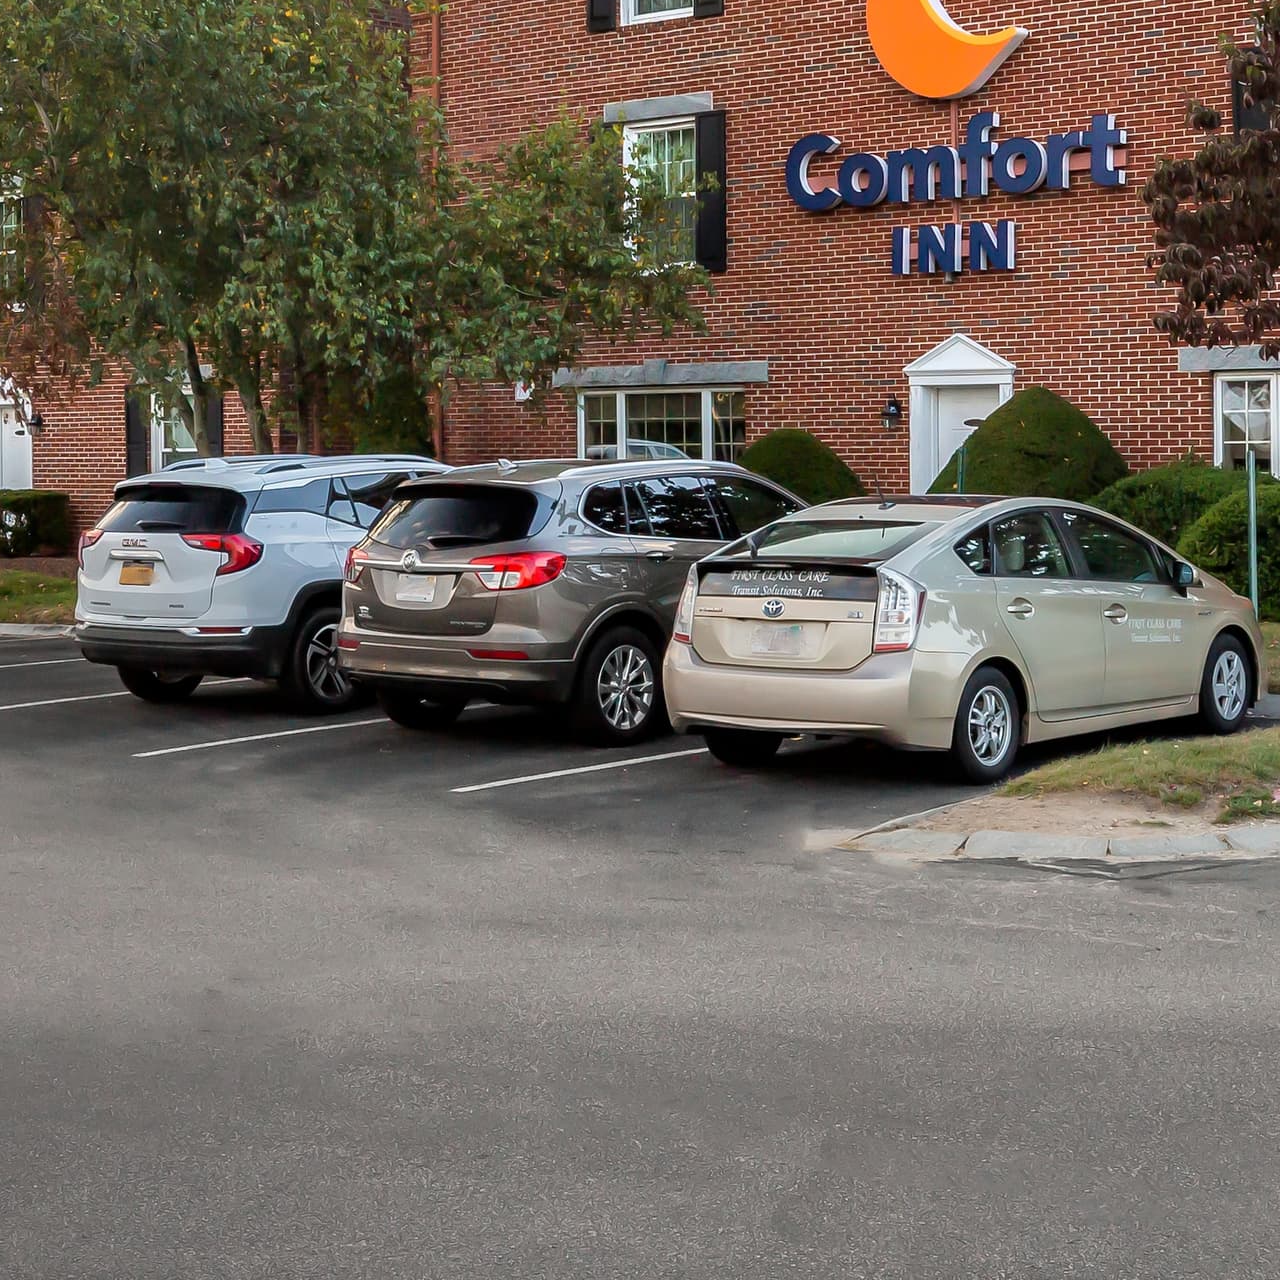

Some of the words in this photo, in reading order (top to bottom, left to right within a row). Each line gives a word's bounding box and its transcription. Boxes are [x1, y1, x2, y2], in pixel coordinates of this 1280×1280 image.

[785, 111, 1127, 211] Comfort
[892, 220, 1015, 275] INN
[731, 570, 760, 581] FIRST
[762, 570, 794, 581] CLASS
[798, 571, 830, 583] CARE
[731, 585, 759, 596] Transit
[760, 584, 803, 597] Solutions,
[806, 587, 824, 597] Inc.
